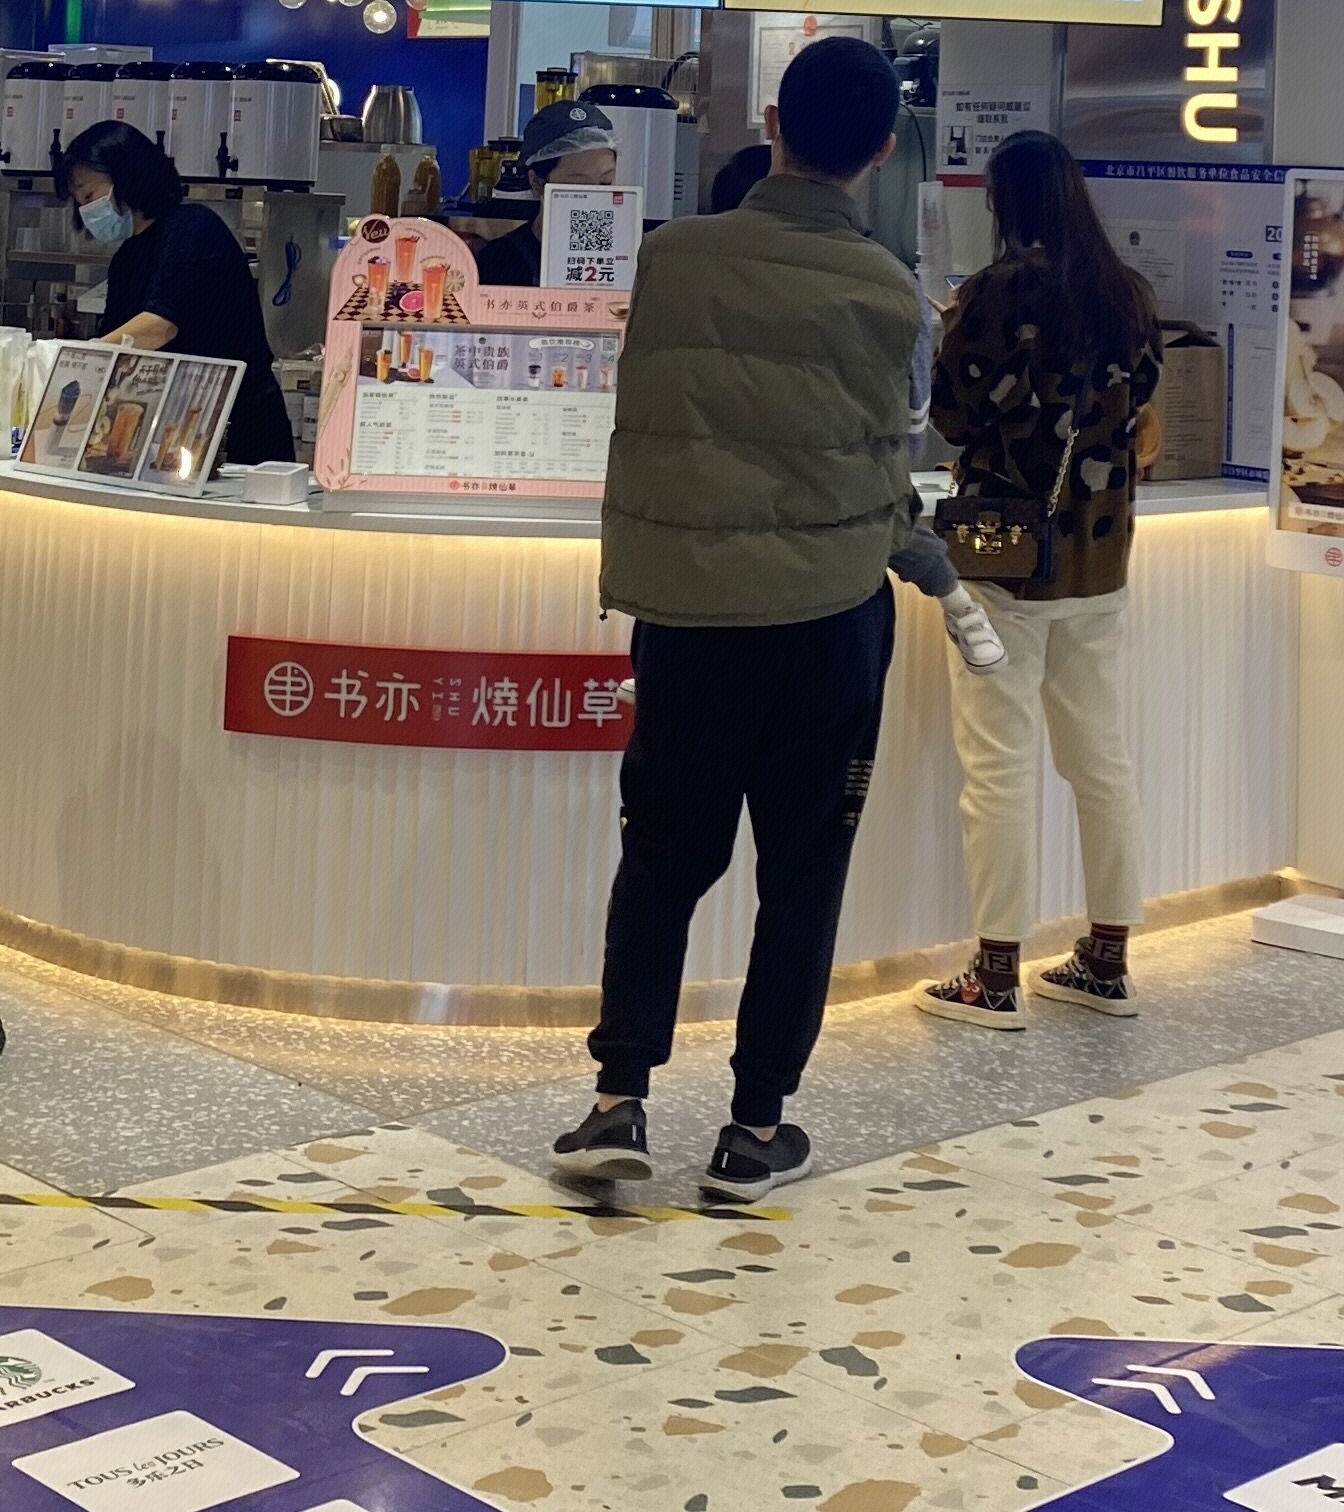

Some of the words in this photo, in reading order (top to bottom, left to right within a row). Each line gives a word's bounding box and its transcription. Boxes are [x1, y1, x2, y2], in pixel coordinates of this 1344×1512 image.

[565, 266, 615, 283] 减2元
[66, 1466, 133, 1491] TOUS
[152, 1437, 225, 1466] JOURS
[125, 1458, 205, 1488] 多乐之日
